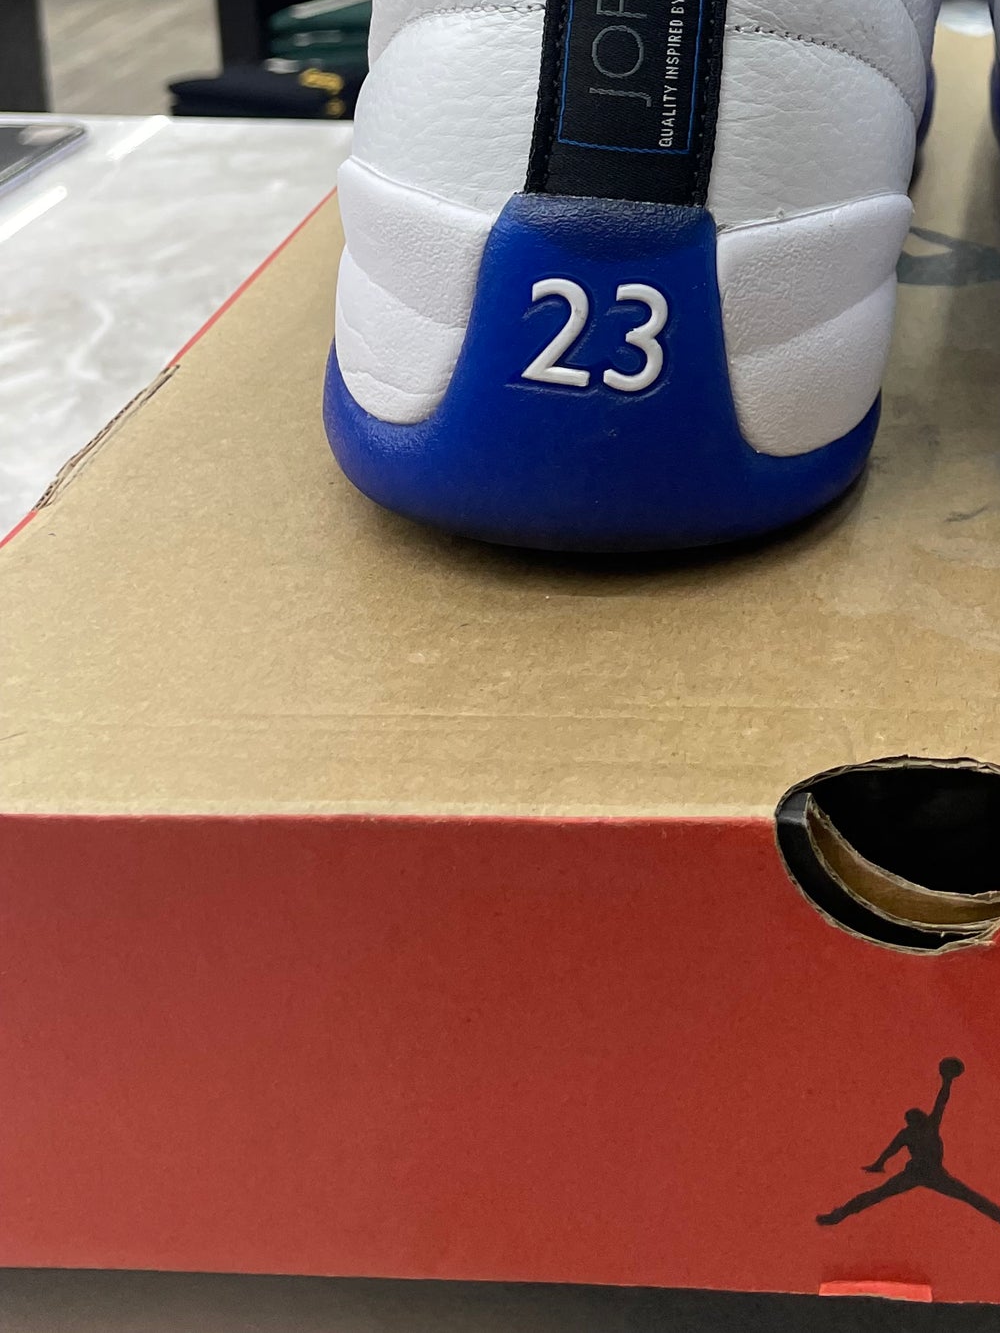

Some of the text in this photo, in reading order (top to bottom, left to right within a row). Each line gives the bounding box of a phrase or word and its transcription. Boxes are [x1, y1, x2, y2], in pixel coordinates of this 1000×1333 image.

[665, 19, 684, 79] INSPIRED
[658, 84, 678, 147] QUALITY
[521, 278, 669, 392] 23
